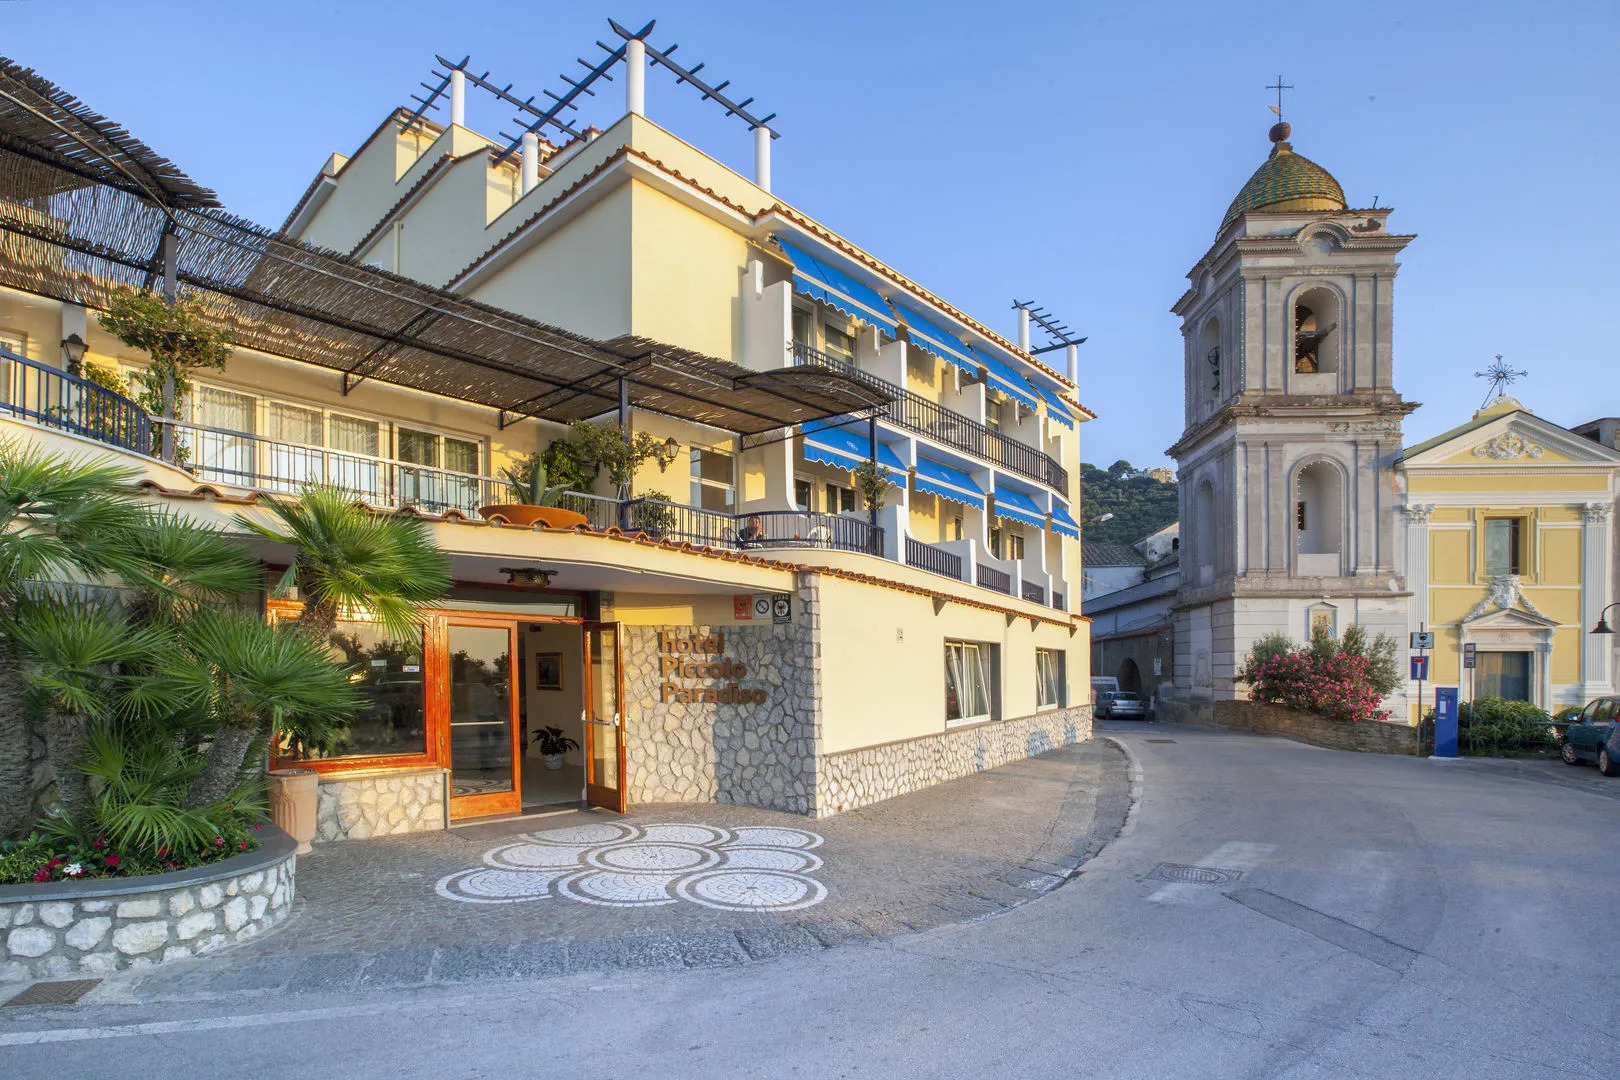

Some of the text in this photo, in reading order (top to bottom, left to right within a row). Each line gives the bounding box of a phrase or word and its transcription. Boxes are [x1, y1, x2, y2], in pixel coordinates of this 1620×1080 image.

[661, 632, 725, 654] hotel
[661, 657, 747, 679] Piccolo
[662, 682, 767, 704] Paradiso
